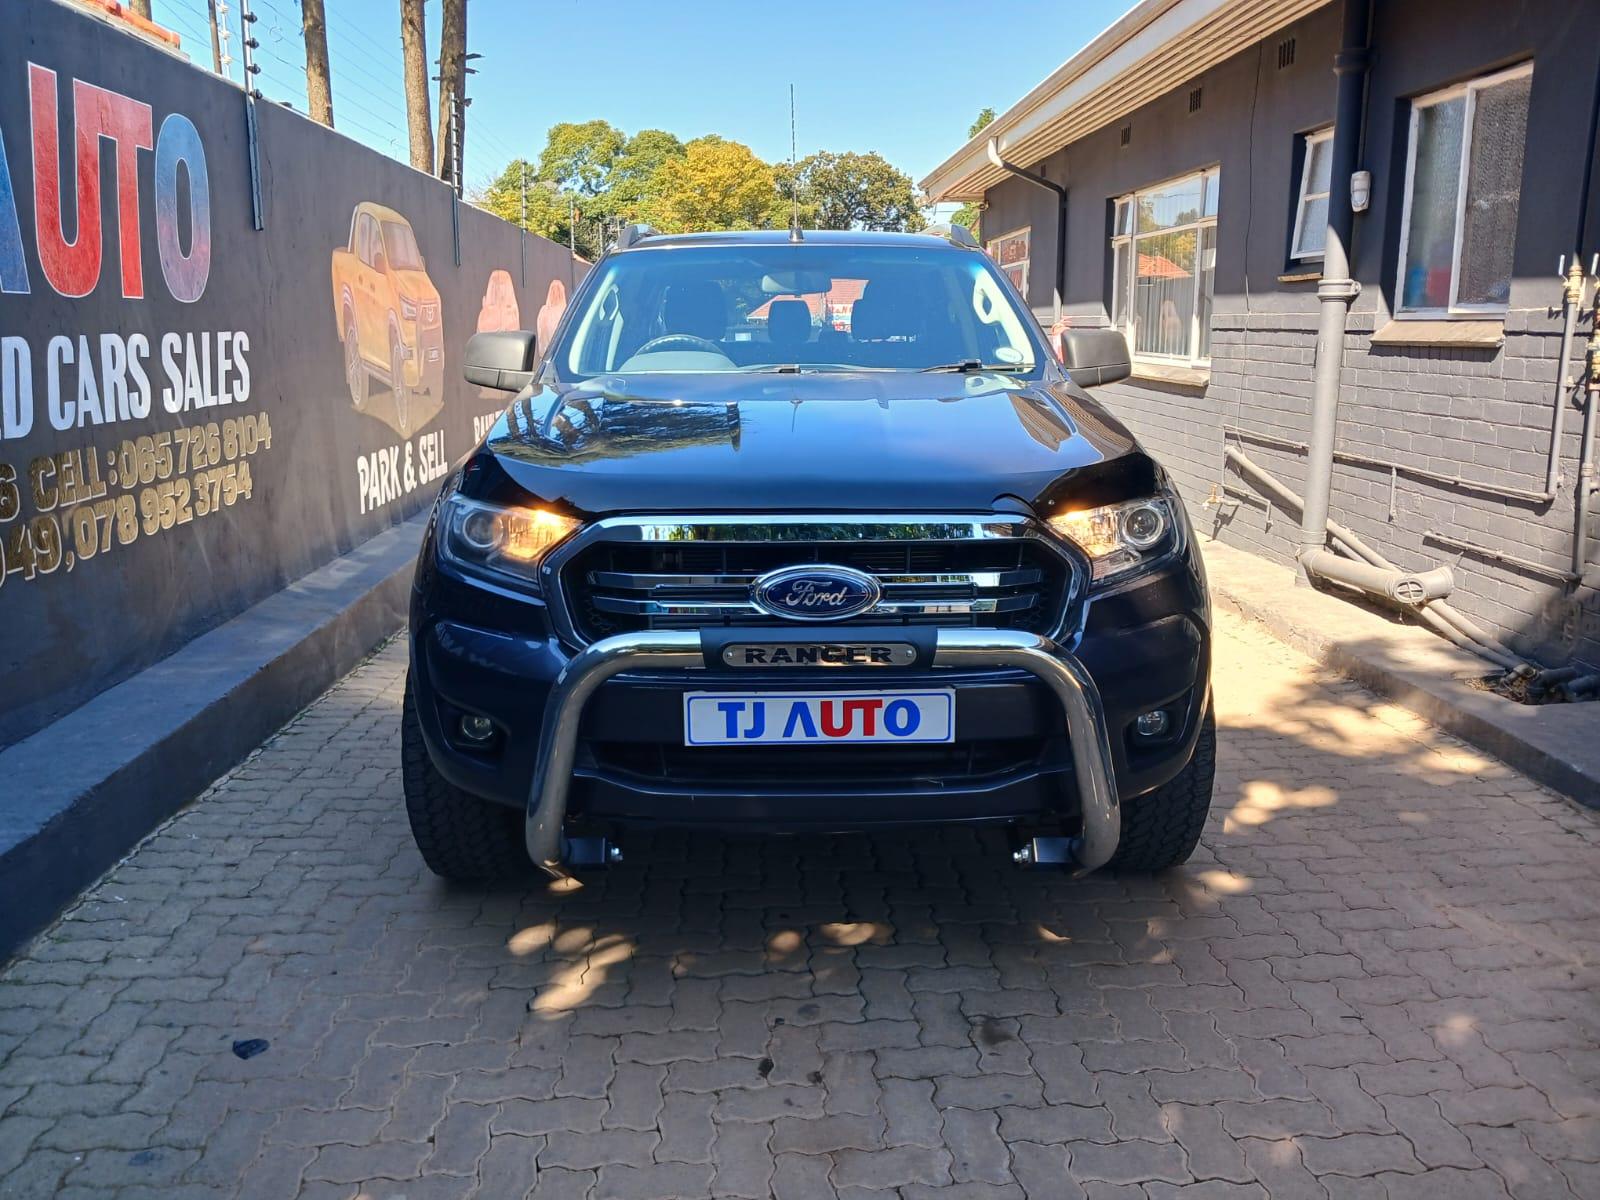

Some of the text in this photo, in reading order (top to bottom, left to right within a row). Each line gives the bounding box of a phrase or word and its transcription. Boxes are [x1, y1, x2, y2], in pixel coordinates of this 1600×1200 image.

[47, 333, 151, 431] CARS
[161, 331, 250, 413] SALES
[357, 429, 448, 514] PARK & SELL
[785, 579, 848, 606] Ford
[745, 646, 893, 664] RANGER
[717, 699, 921, 739] TJ AUTO
